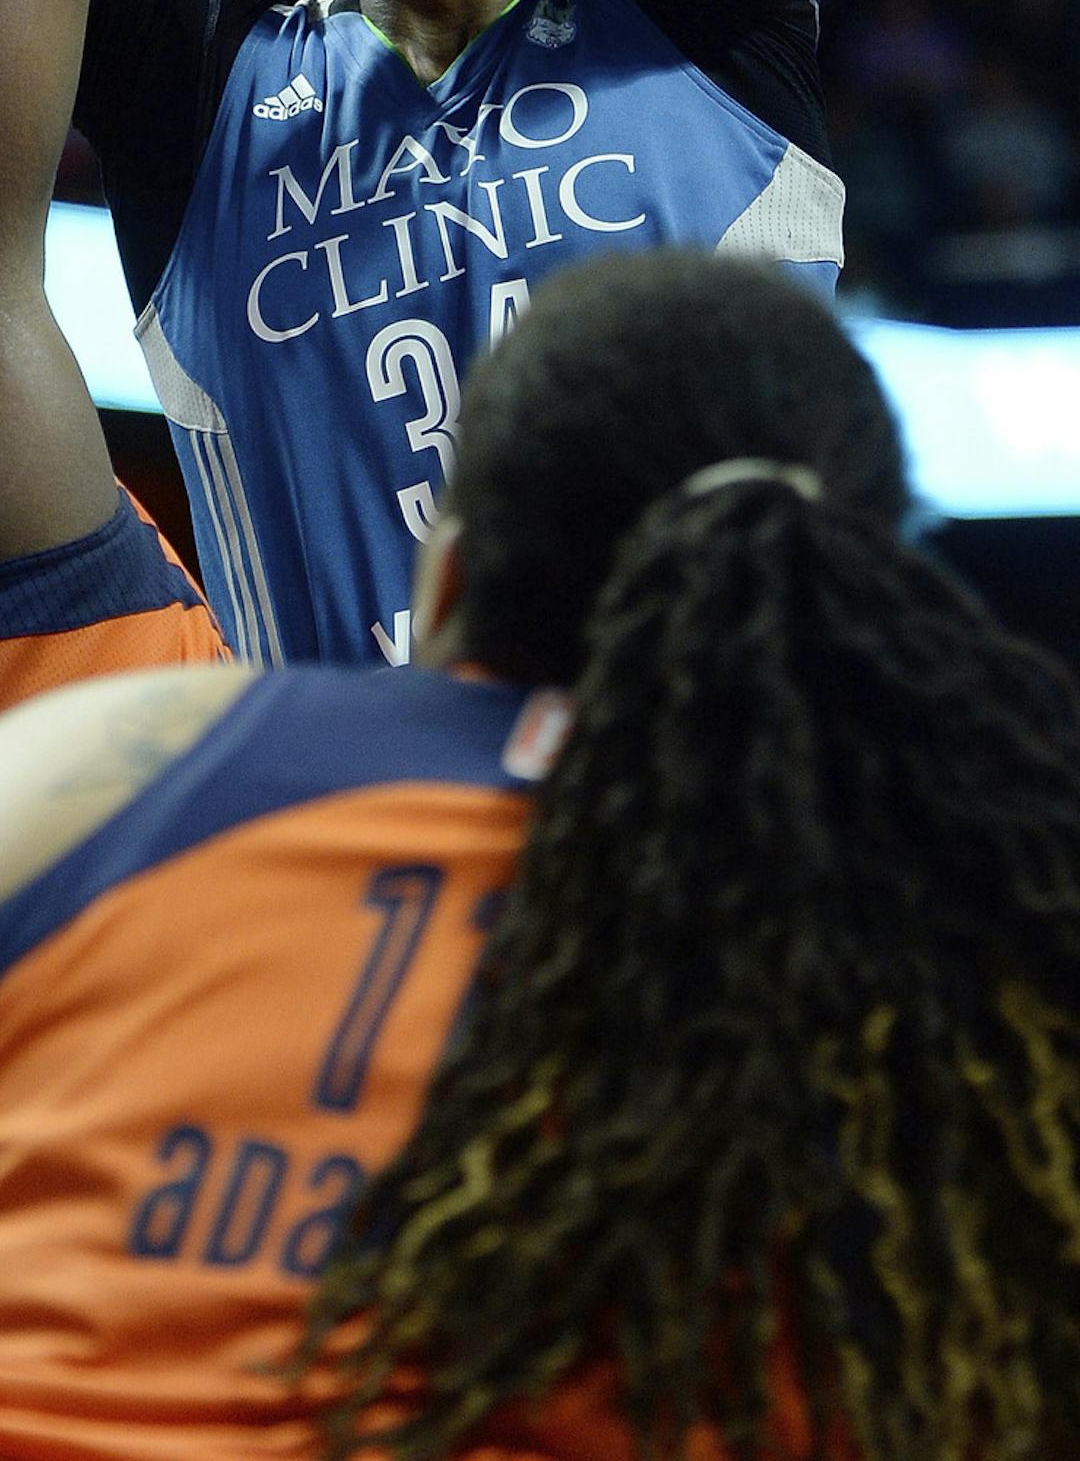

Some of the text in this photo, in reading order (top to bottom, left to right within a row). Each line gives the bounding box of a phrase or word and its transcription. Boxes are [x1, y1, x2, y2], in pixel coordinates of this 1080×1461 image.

[252, 95, 324, 121] adidas
[266, 81, 590, 242] MAYO
[245, 153, 647, 343] CLINIC
[310, 862, 508, 1113] 1
